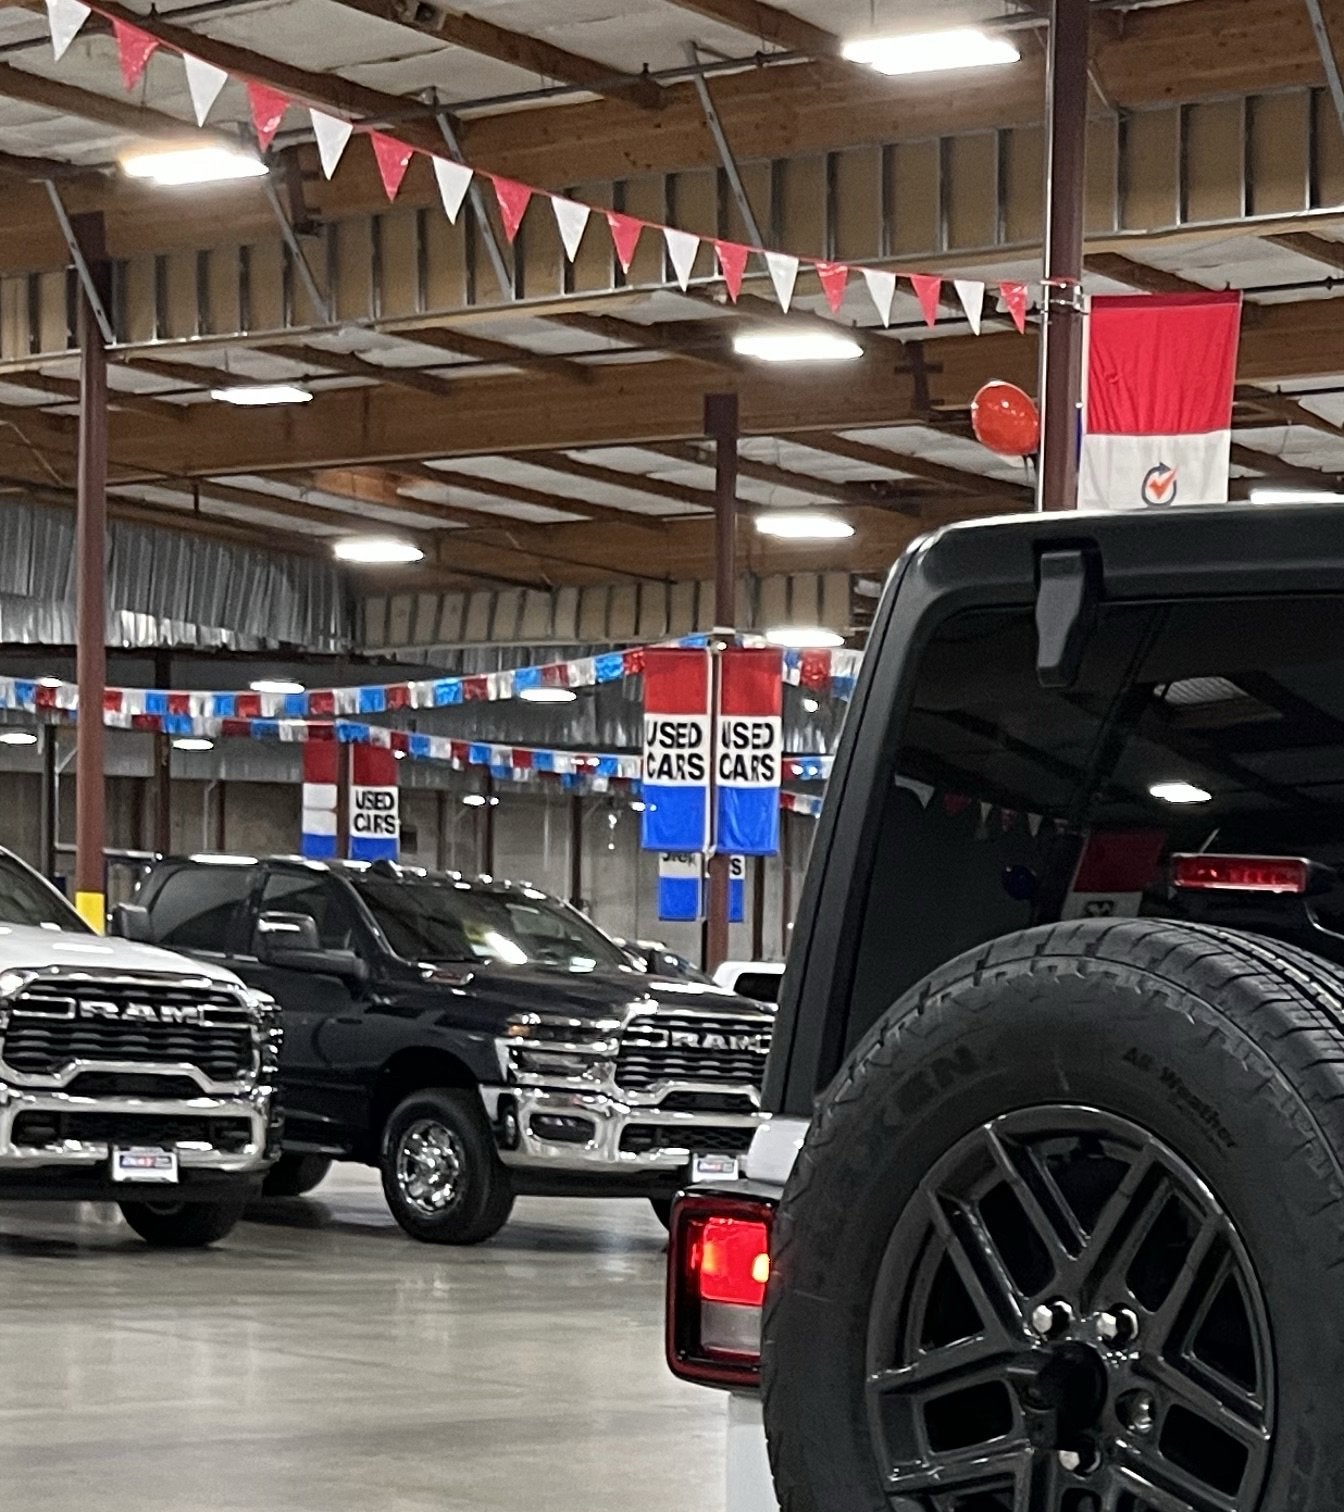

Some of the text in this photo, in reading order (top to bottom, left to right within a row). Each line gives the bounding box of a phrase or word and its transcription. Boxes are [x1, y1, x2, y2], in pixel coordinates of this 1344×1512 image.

[646, 721, 703, 750] USED
[722, 721, 775, 750] USED
[646, 753, 706, 781] CARS
[719, 753, 775, 782] CARS
[355, 789, 395, 811] USED
[79, 999, 201, 1024] RAM
[671, 1031, 757, 1051] RAM
